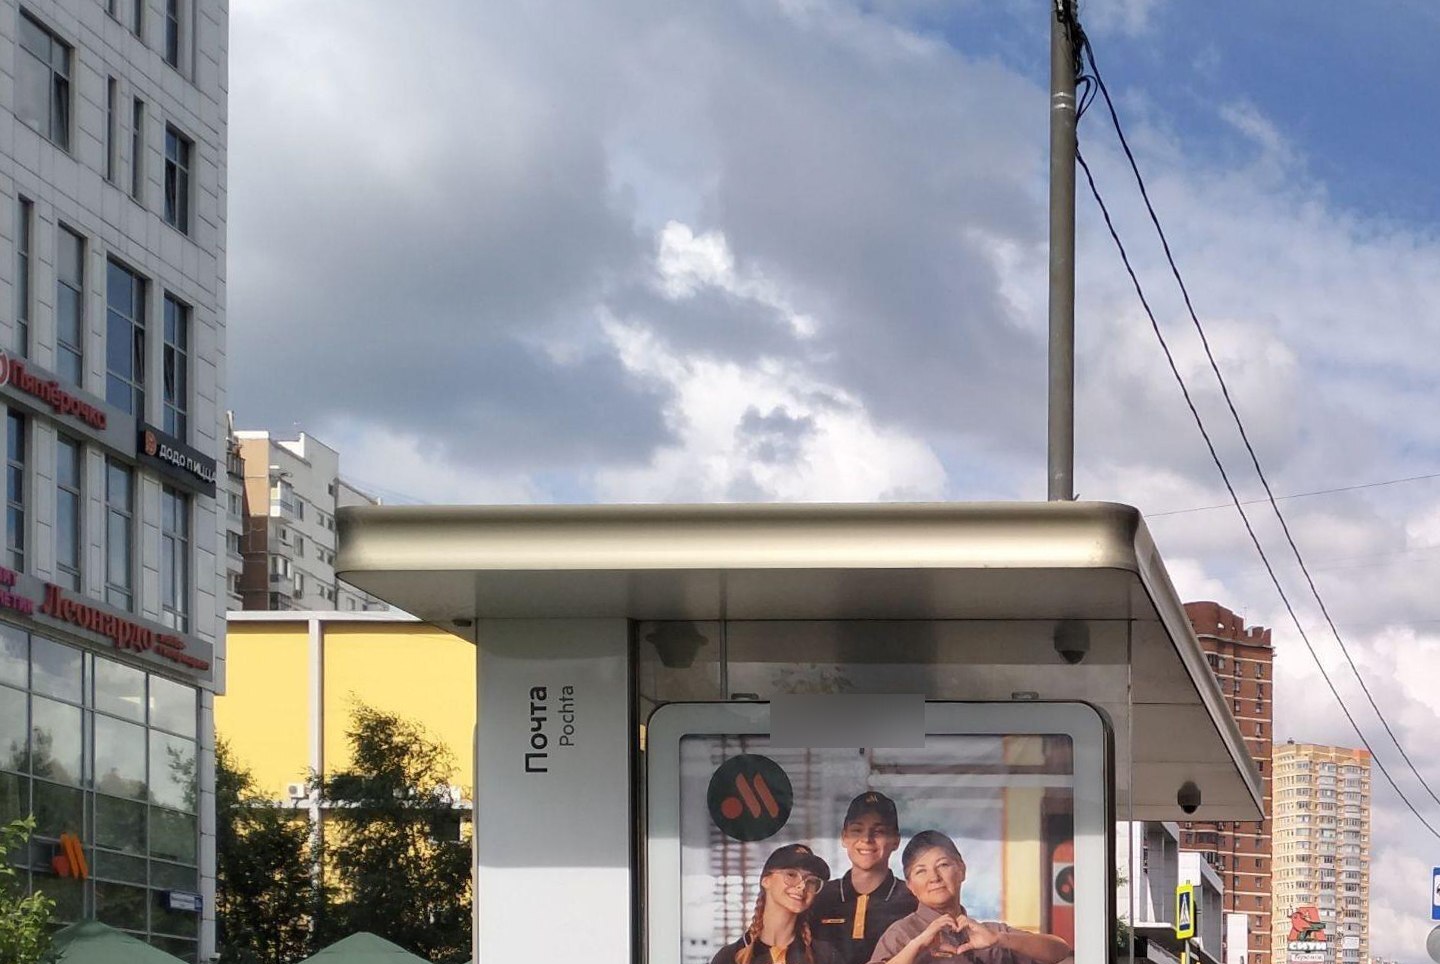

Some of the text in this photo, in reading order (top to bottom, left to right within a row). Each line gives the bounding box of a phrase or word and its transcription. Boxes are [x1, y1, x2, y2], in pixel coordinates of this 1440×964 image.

[159, 443, 186, 467] ДОДО
[40, 582, 153, 654] Леонардо
[525, 686, 548, 773] Почта
[557, 685, 575, 746] Pochta
